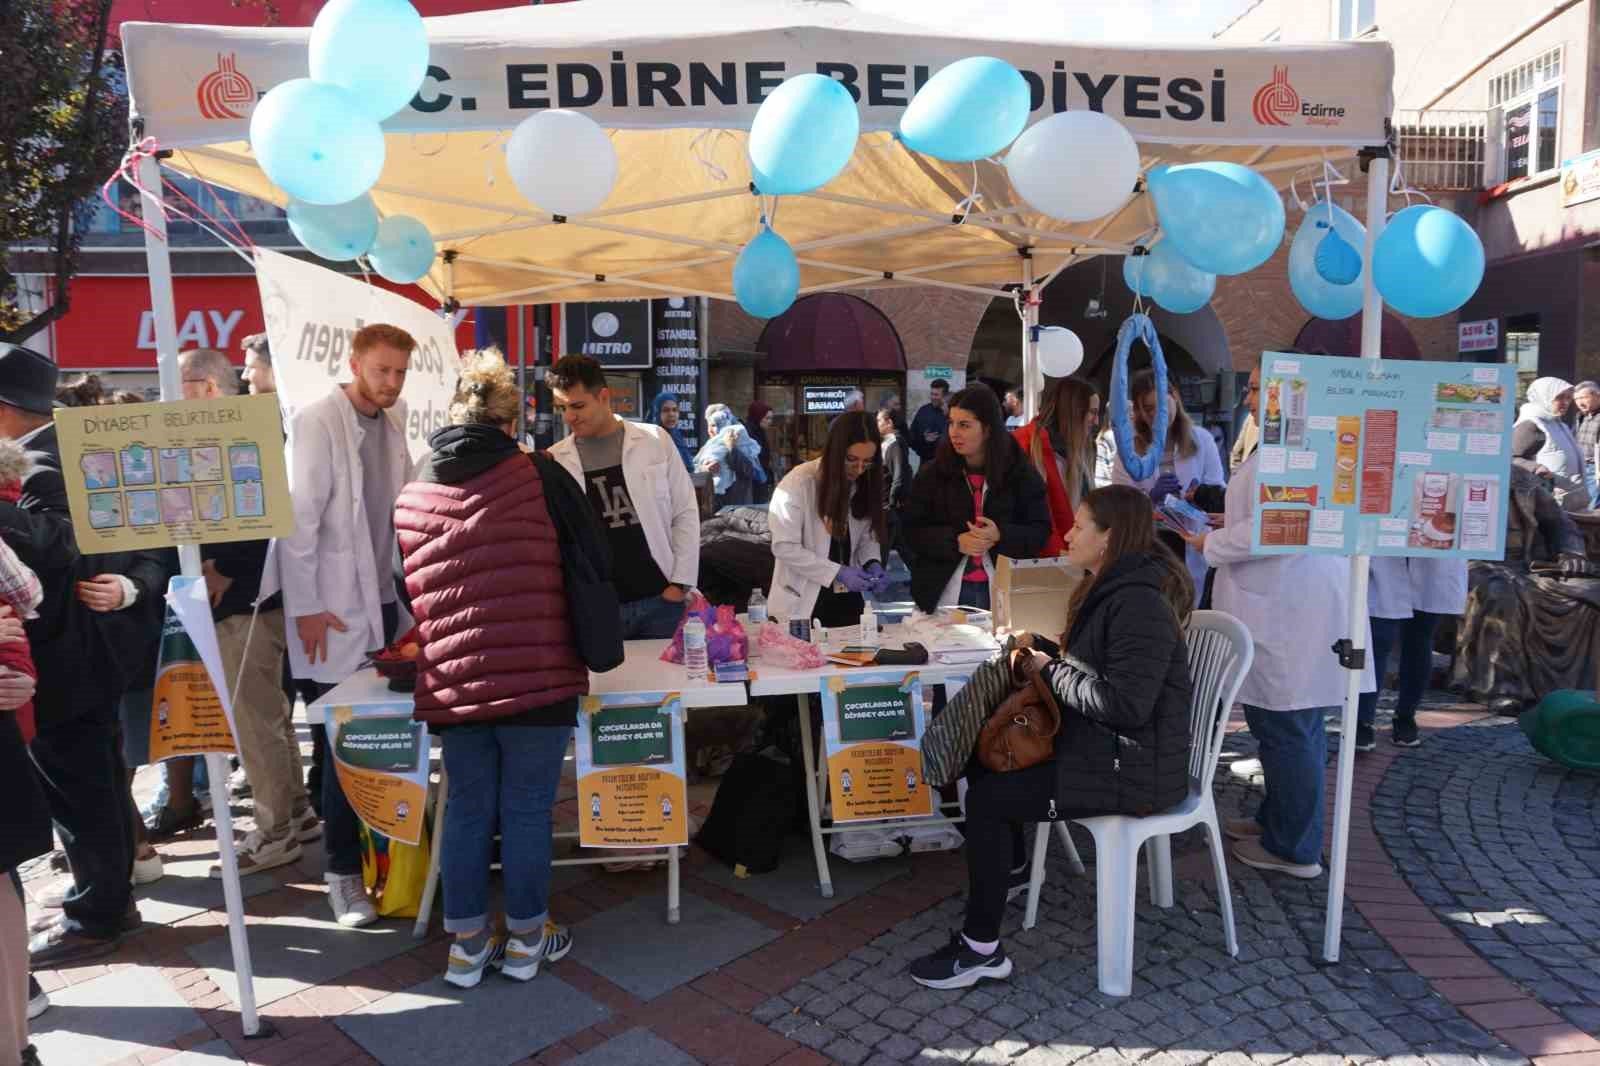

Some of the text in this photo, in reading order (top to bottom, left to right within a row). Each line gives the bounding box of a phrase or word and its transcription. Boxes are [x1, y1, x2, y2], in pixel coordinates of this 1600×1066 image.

[506, 51, 787, 110] EDİRNE
[1301, 103, 1345, 117] Edirne
[581, 342, 633, 355] METRO
[662, 383, 697, 394] ANKARA
[83, 406, 243, 434] DİYABET BELİRTİLERİ
[591, 475, 641, 528] LA
